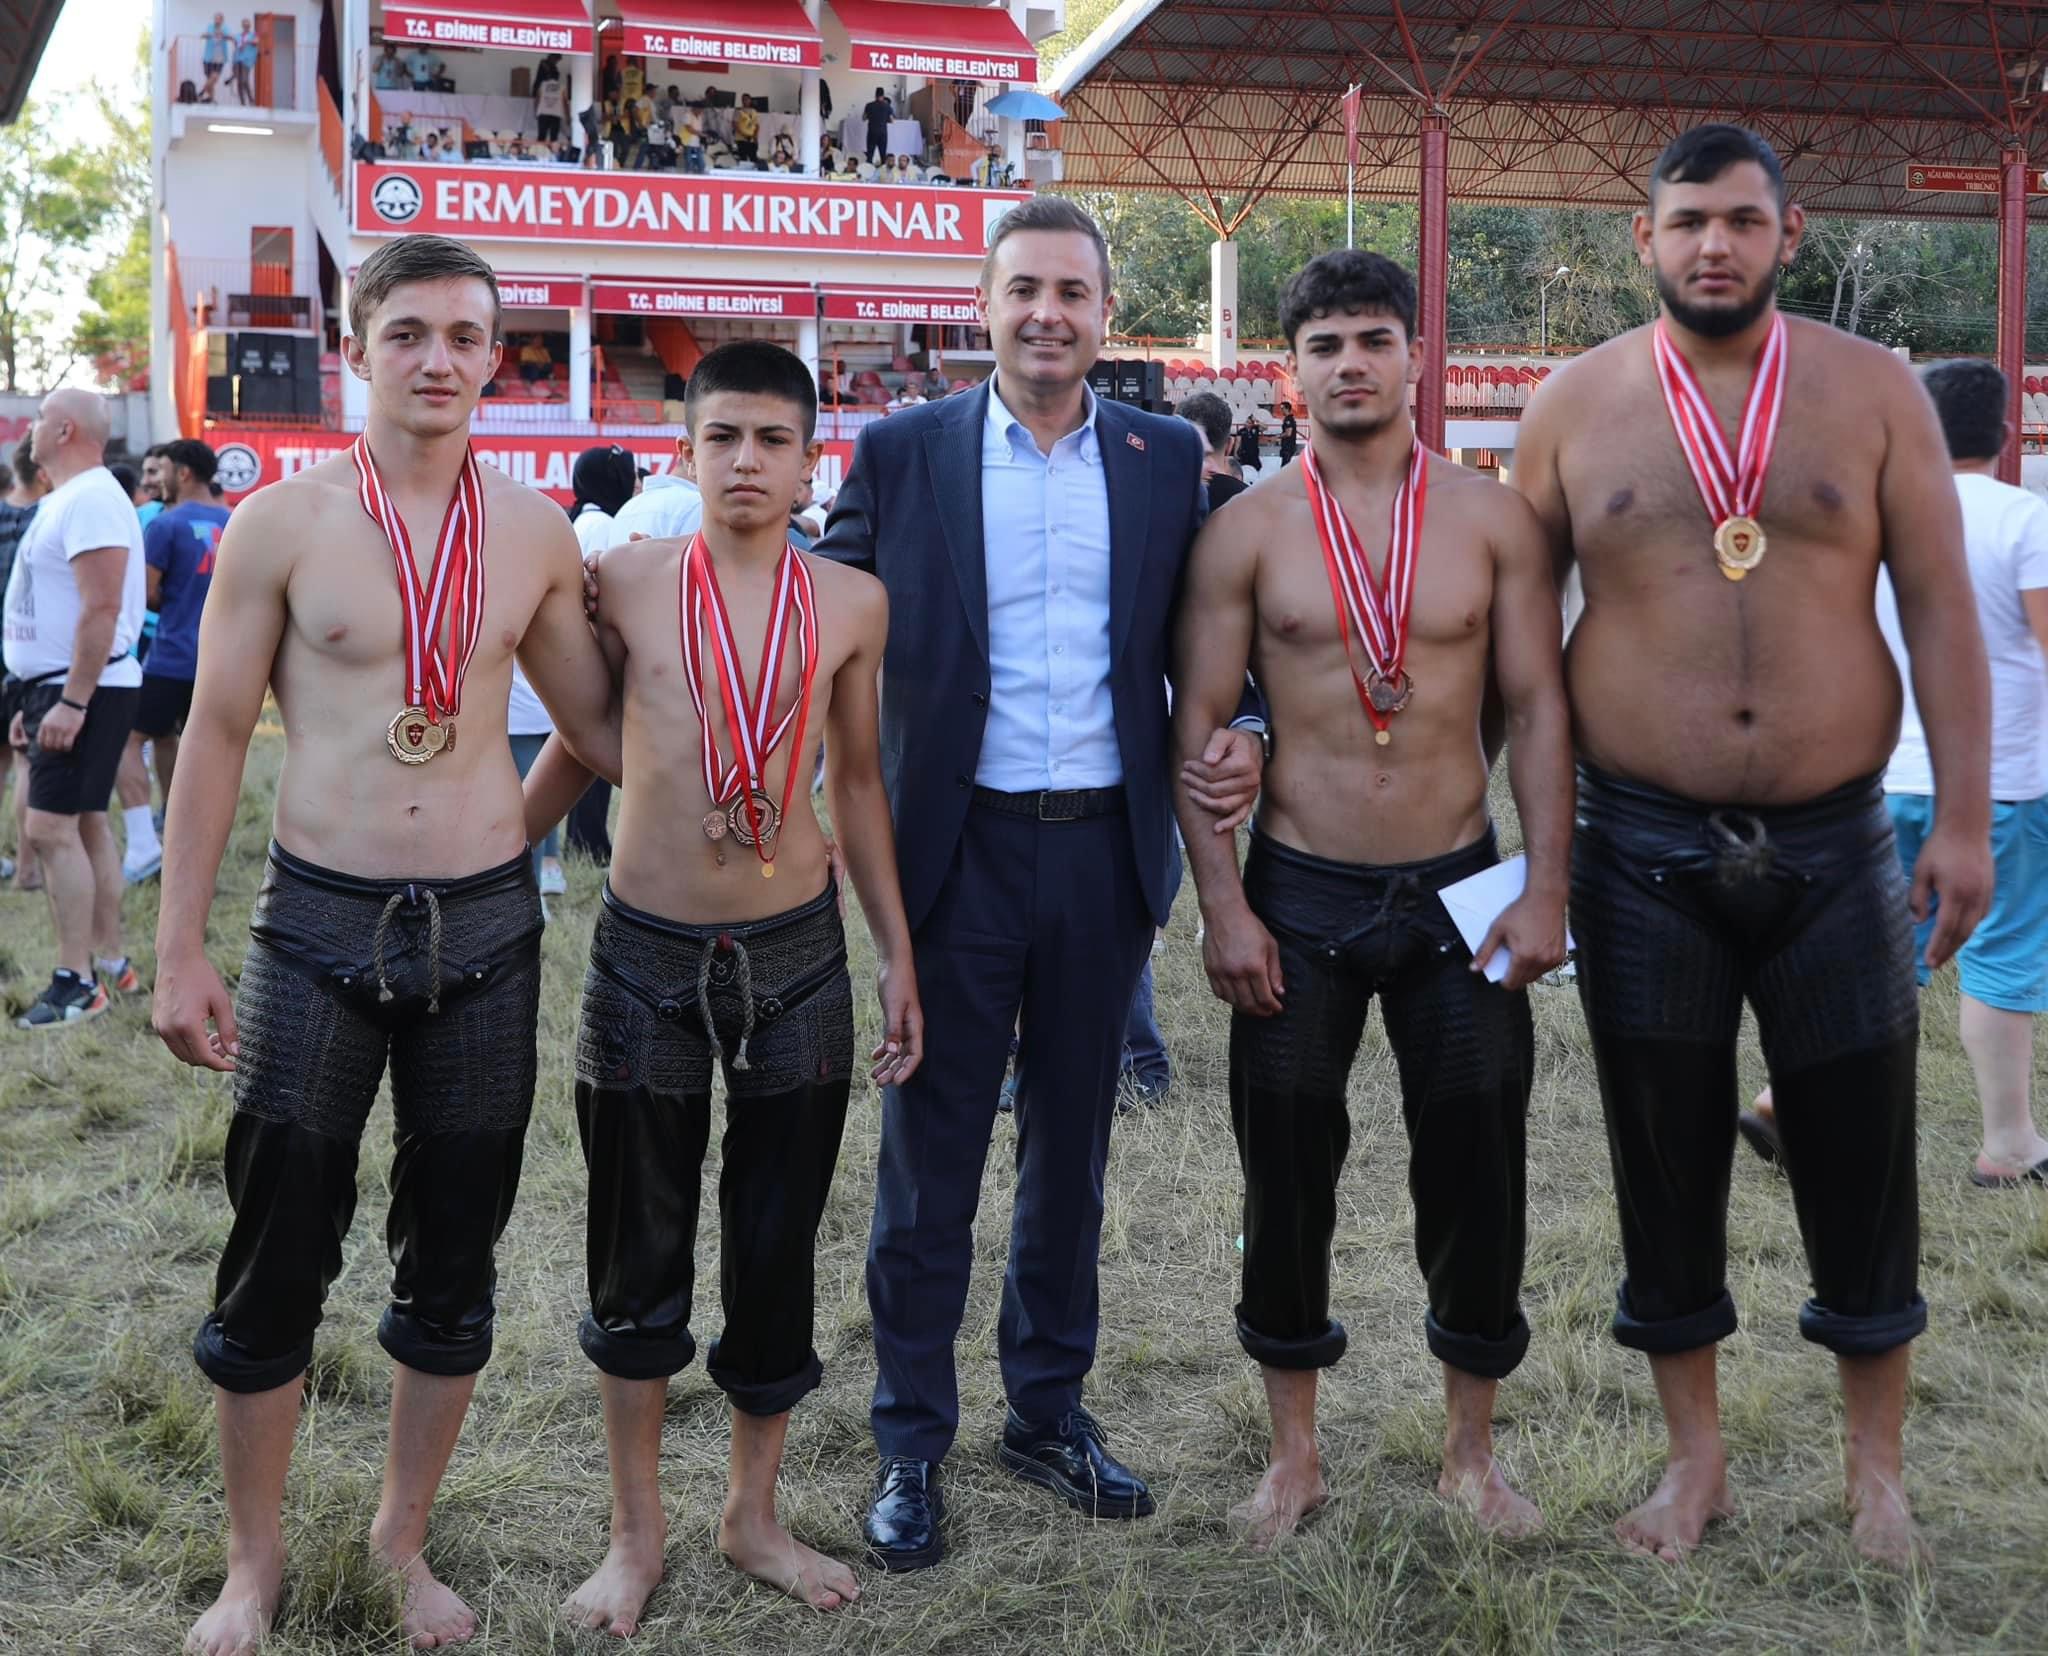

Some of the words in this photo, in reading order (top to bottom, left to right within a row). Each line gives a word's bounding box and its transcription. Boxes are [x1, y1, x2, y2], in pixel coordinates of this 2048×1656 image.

[405, 19, 432, 38] T.C.
[434, 19, 488, 42] EDİRNE
[490, 26, 572, 49] BELEDİYESİ
[643, 35, 668, 52] T.C.
[671, 35, 721, 57] EDİRNE
[724, 42, 801, 63] BELEDİYESİ
[869, 52, 893, 68] T.C.
[895, 52, 944, 73] EDİRNE
[946, 58, 1019, 78] BELEDİYESİ
[435, 179, 710, 232] ERMEYDANI
[722, 193, 964, 241] KIRKPINAR
[628, 293, 653, 310] T.C.
[655, 291, 705, 312] EDİRNE
[707, 294, 783, 313] BELEDİYESİ
[856, 301, 879, 317] T.C.
[882, 300, 928, 319] EDİRNE
[930, 302, 980, 320] BELEDİY
